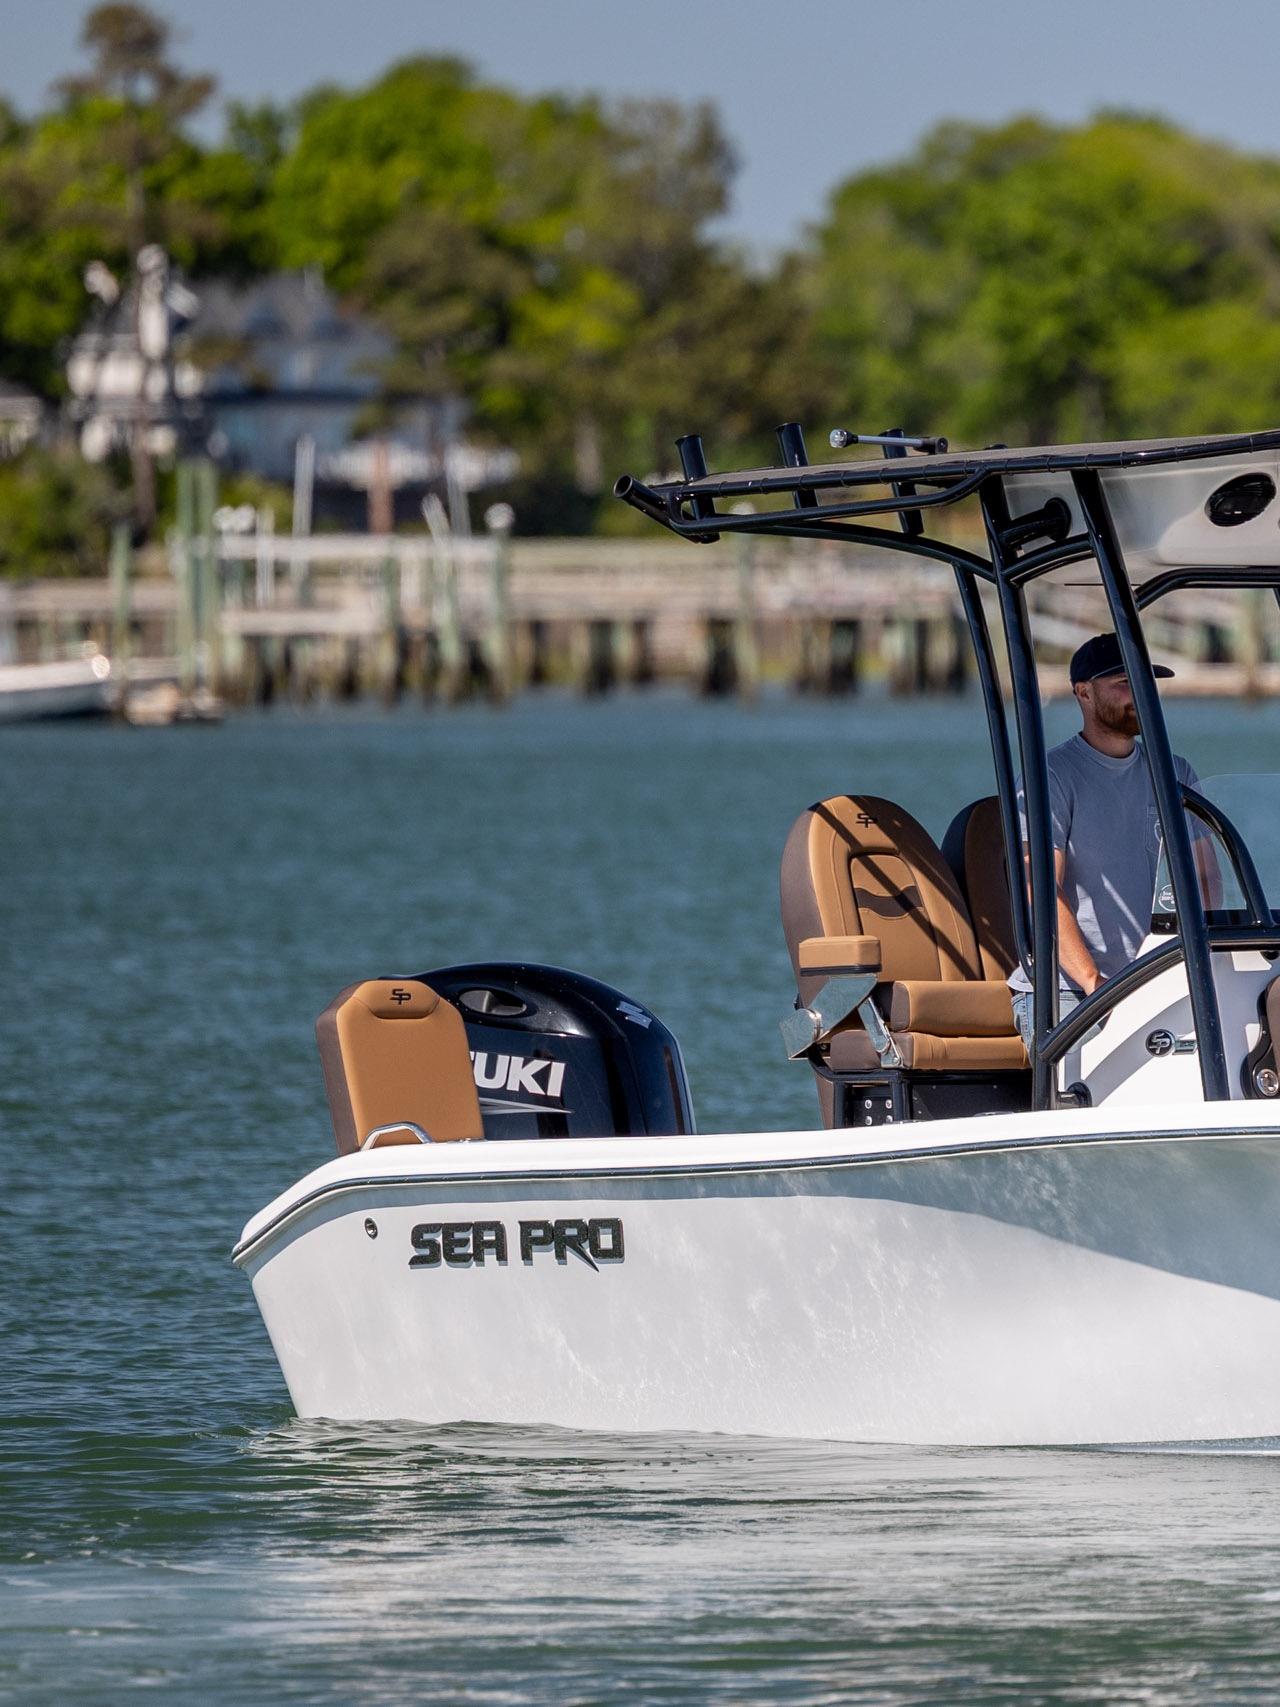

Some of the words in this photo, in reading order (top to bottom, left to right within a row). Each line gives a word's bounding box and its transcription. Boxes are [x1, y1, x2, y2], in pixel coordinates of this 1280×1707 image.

[469, 1050, 567, 1098] UKI
[408, 1220, 508, 1270] SEA
[518, 1217, 625, 1273] PRO
